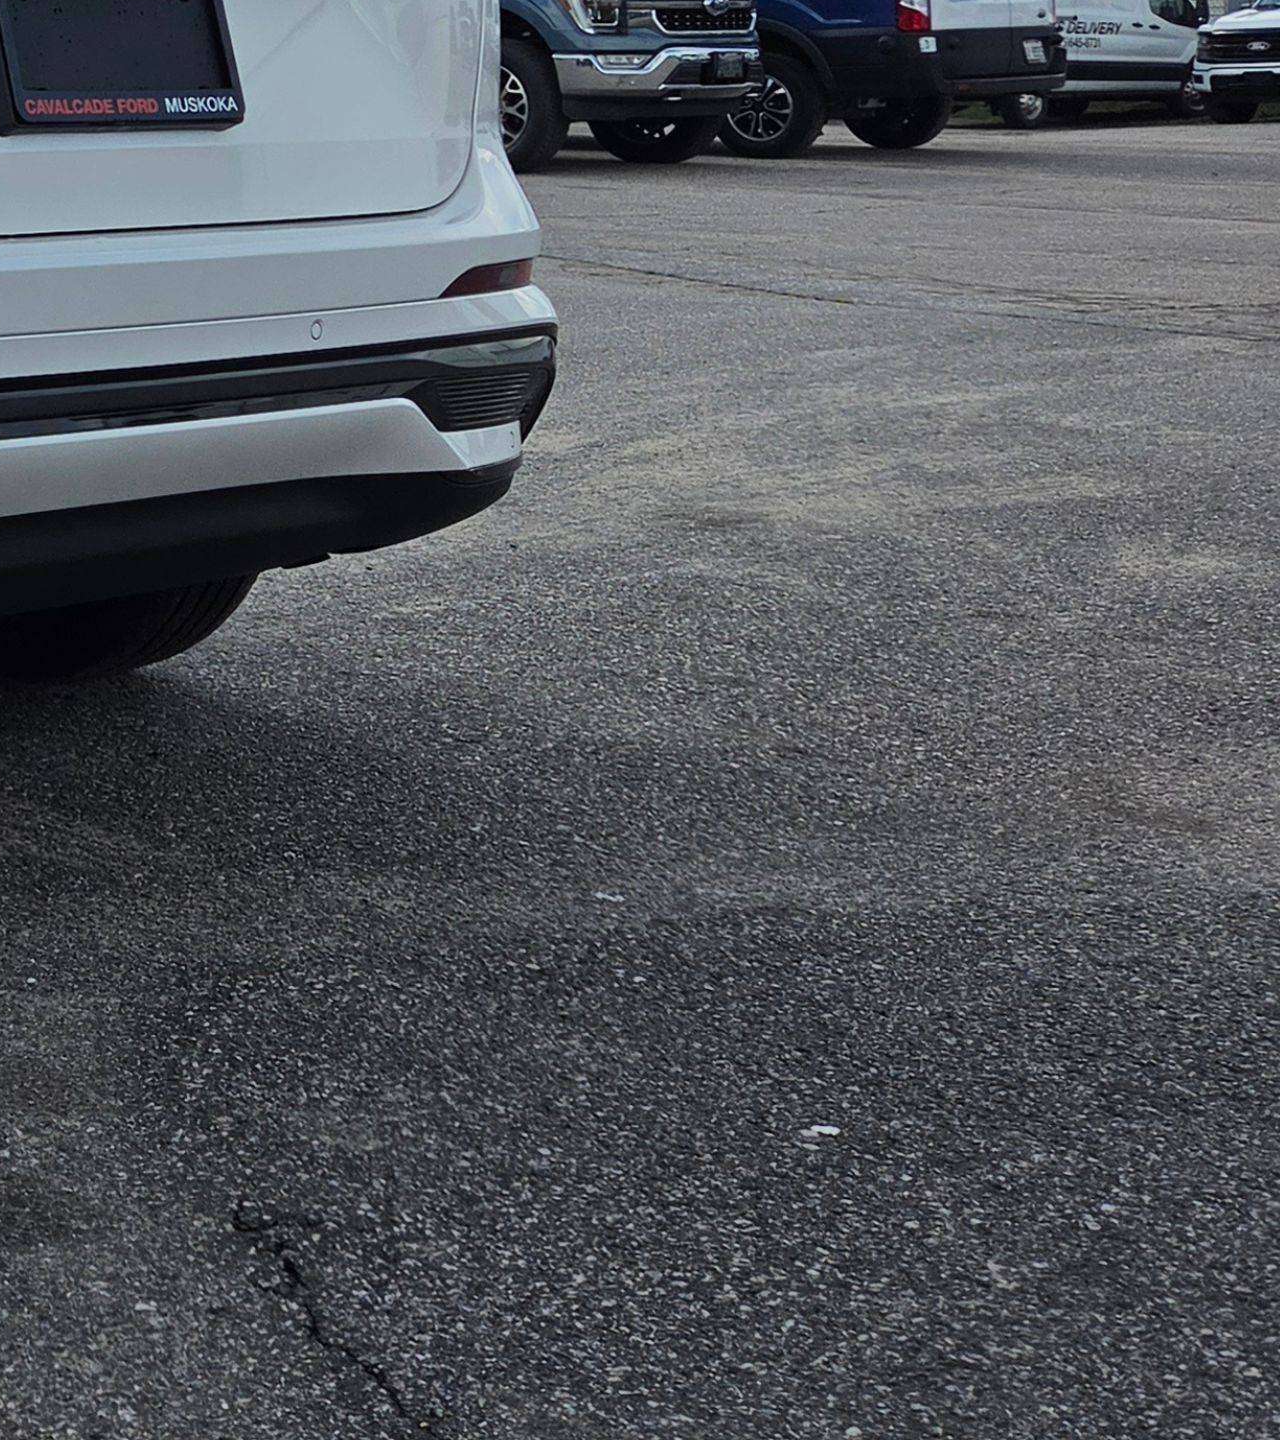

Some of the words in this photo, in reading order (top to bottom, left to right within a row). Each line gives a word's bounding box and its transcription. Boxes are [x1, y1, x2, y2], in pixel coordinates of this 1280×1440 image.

[1065, 20, 1123, 35] DELIVERY
[24, 97, 115, 115] CAVALCADE
[117, 97, 160, 114] FORD
[164, 96, 239, 113] MUSKOKA
